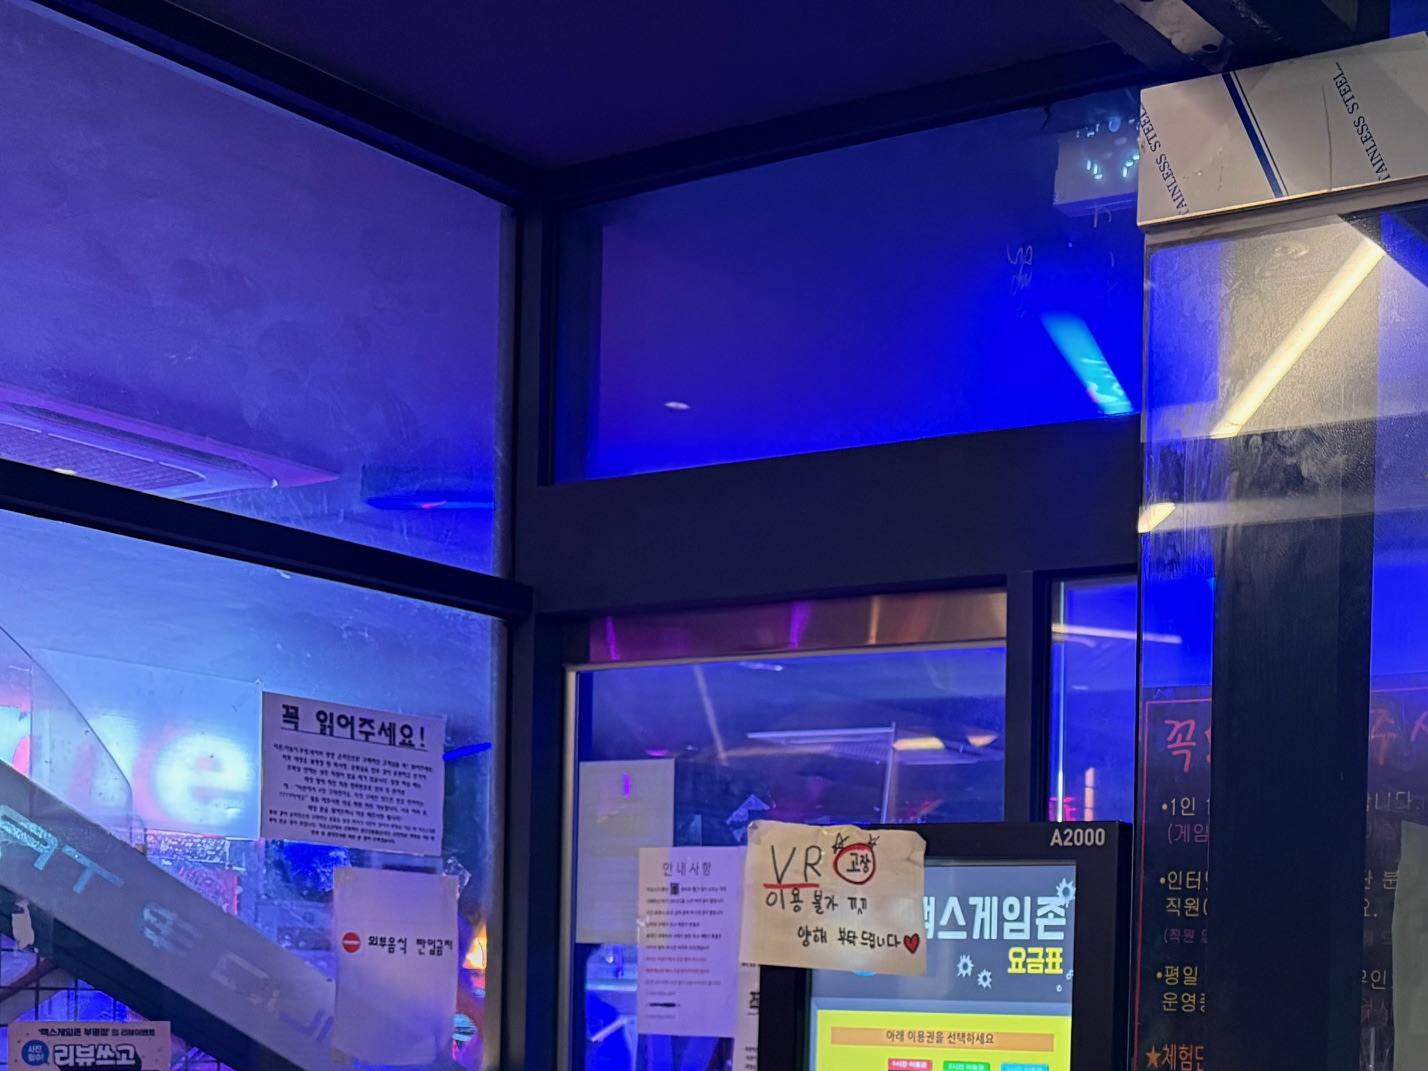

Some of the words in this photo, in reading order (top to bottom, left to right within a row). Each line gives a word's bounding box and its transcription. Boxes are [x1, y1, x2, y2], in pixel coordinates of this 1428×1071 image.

[281, 704, 300, 731] 꼭
[315, 709, 426, 749] 읽어주세요!
[1050, 829, 1106, 846] A2000
[771, 845, 823, 884] VR
[846, 852, 871, 873] 고장
[765, 888, 804, 914] 이용
[812, 893, 839, 914] 불가
[367, 935, 408, 955] 외부음식
[797, 926, 828, 948] 양해
[1007, 947, 1064, 975] 요금표
[1163, 965, 1198, 987] 평일
[886, 1030, 905, 1043] 아래
[907, 1031, 945, 1044] 이용권을
[947, 1032, 995, 1046] 선택하세요
[53, 1044, 136, 1067] 리뷰쓰고
